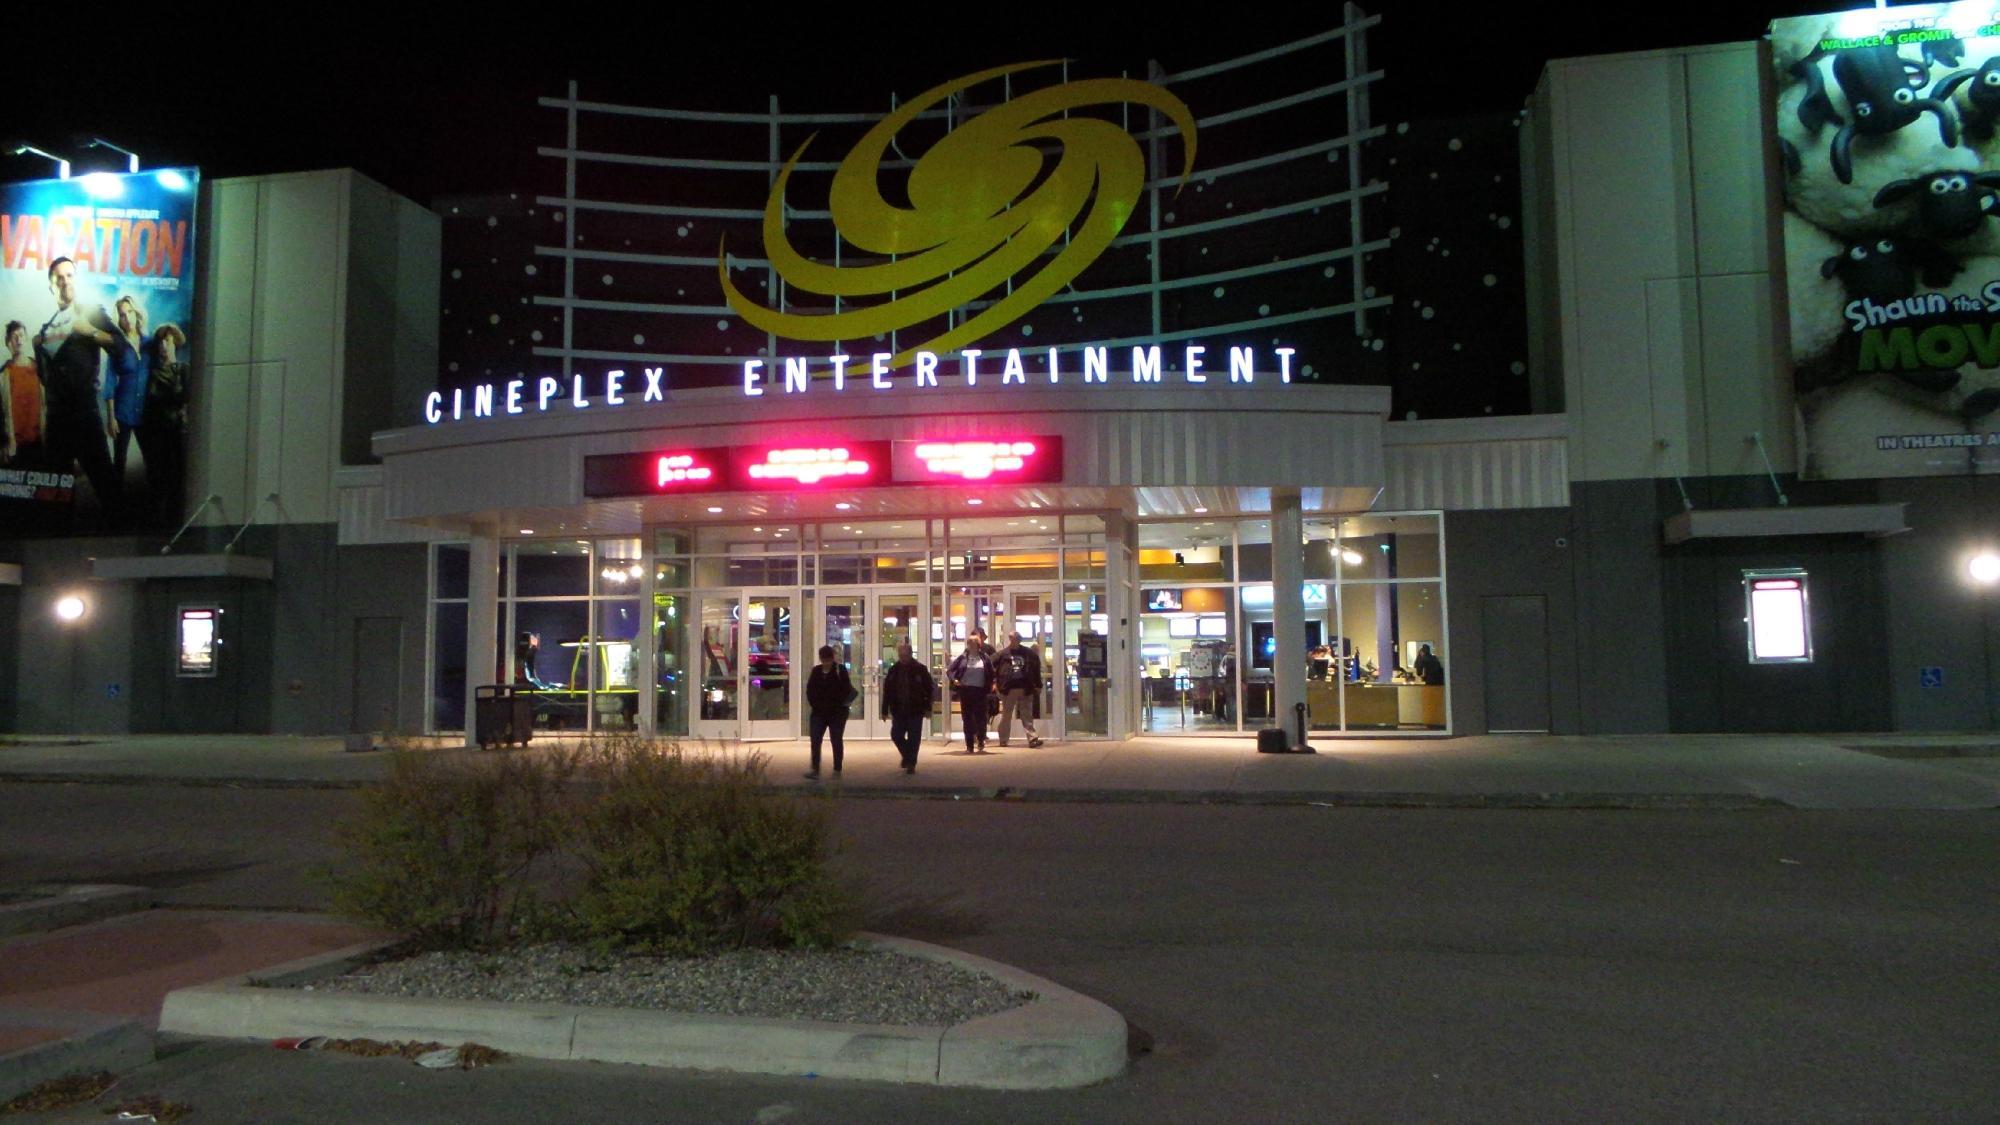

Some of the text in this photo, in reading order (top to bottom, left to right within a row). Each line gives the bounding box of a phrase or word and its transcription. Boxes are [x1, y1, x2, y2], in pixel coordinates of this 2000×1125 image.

[1820, 34, 1881, 51] WALLACE
[1882, 33, 1894, 46] &
[1897, 28, 1953, 45] GROMIT
[1, 213, 187, 277] VACATION
[1844, 293, 1948, 334] Shaun
[1951, 295, 1982, 313] the
[425, 345, 1296, 424] CINEPLEX ENTERTAINMENT
[1877, 437, 1897, 449] IN
[1901, 434, 1983, 449] THEATRES
